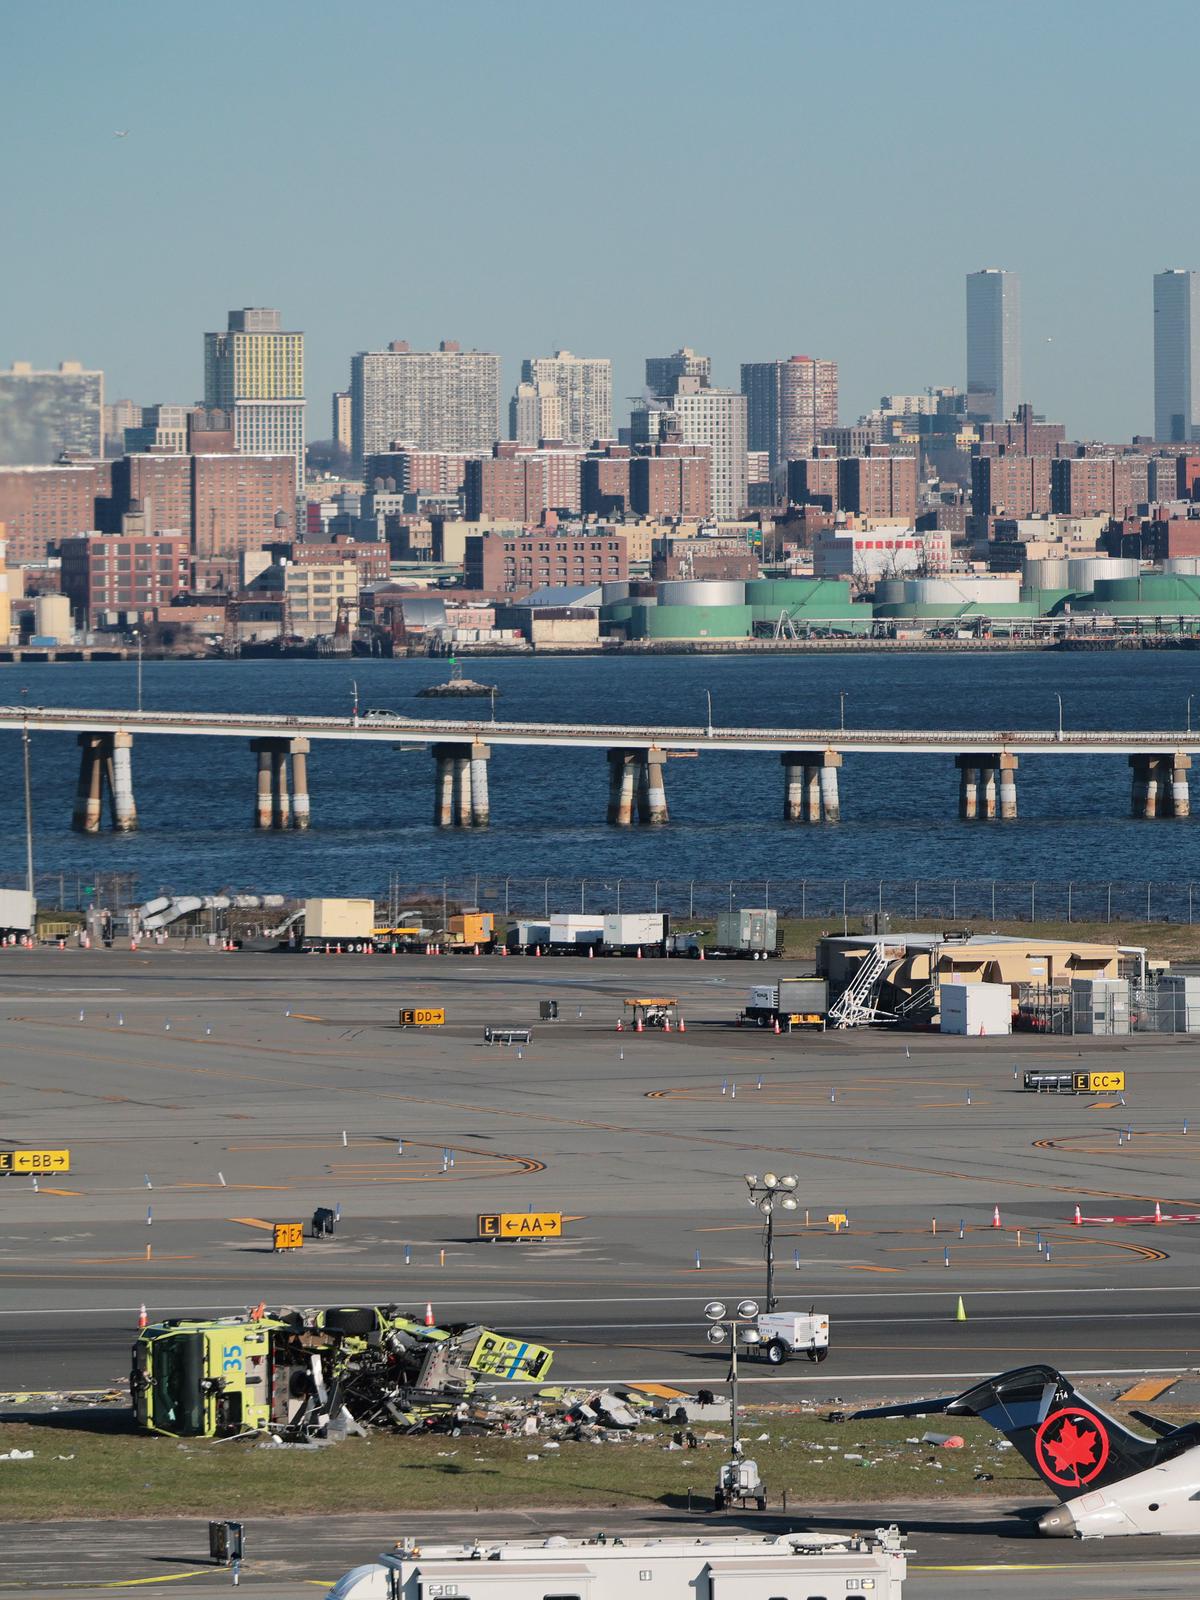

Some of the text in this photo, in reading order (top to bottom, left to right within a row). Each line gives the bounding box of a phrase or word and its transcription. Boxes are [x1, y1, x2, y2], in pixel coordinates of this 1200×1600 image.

[404, 1012, 431, 1021] E DD
[1078, 1076, 1108, 1087] E CC
[32, 1155, 51, 1167] BB
[485, 1218, 542, 1233] E AA
[223, 1345, 242, 1371] 35
